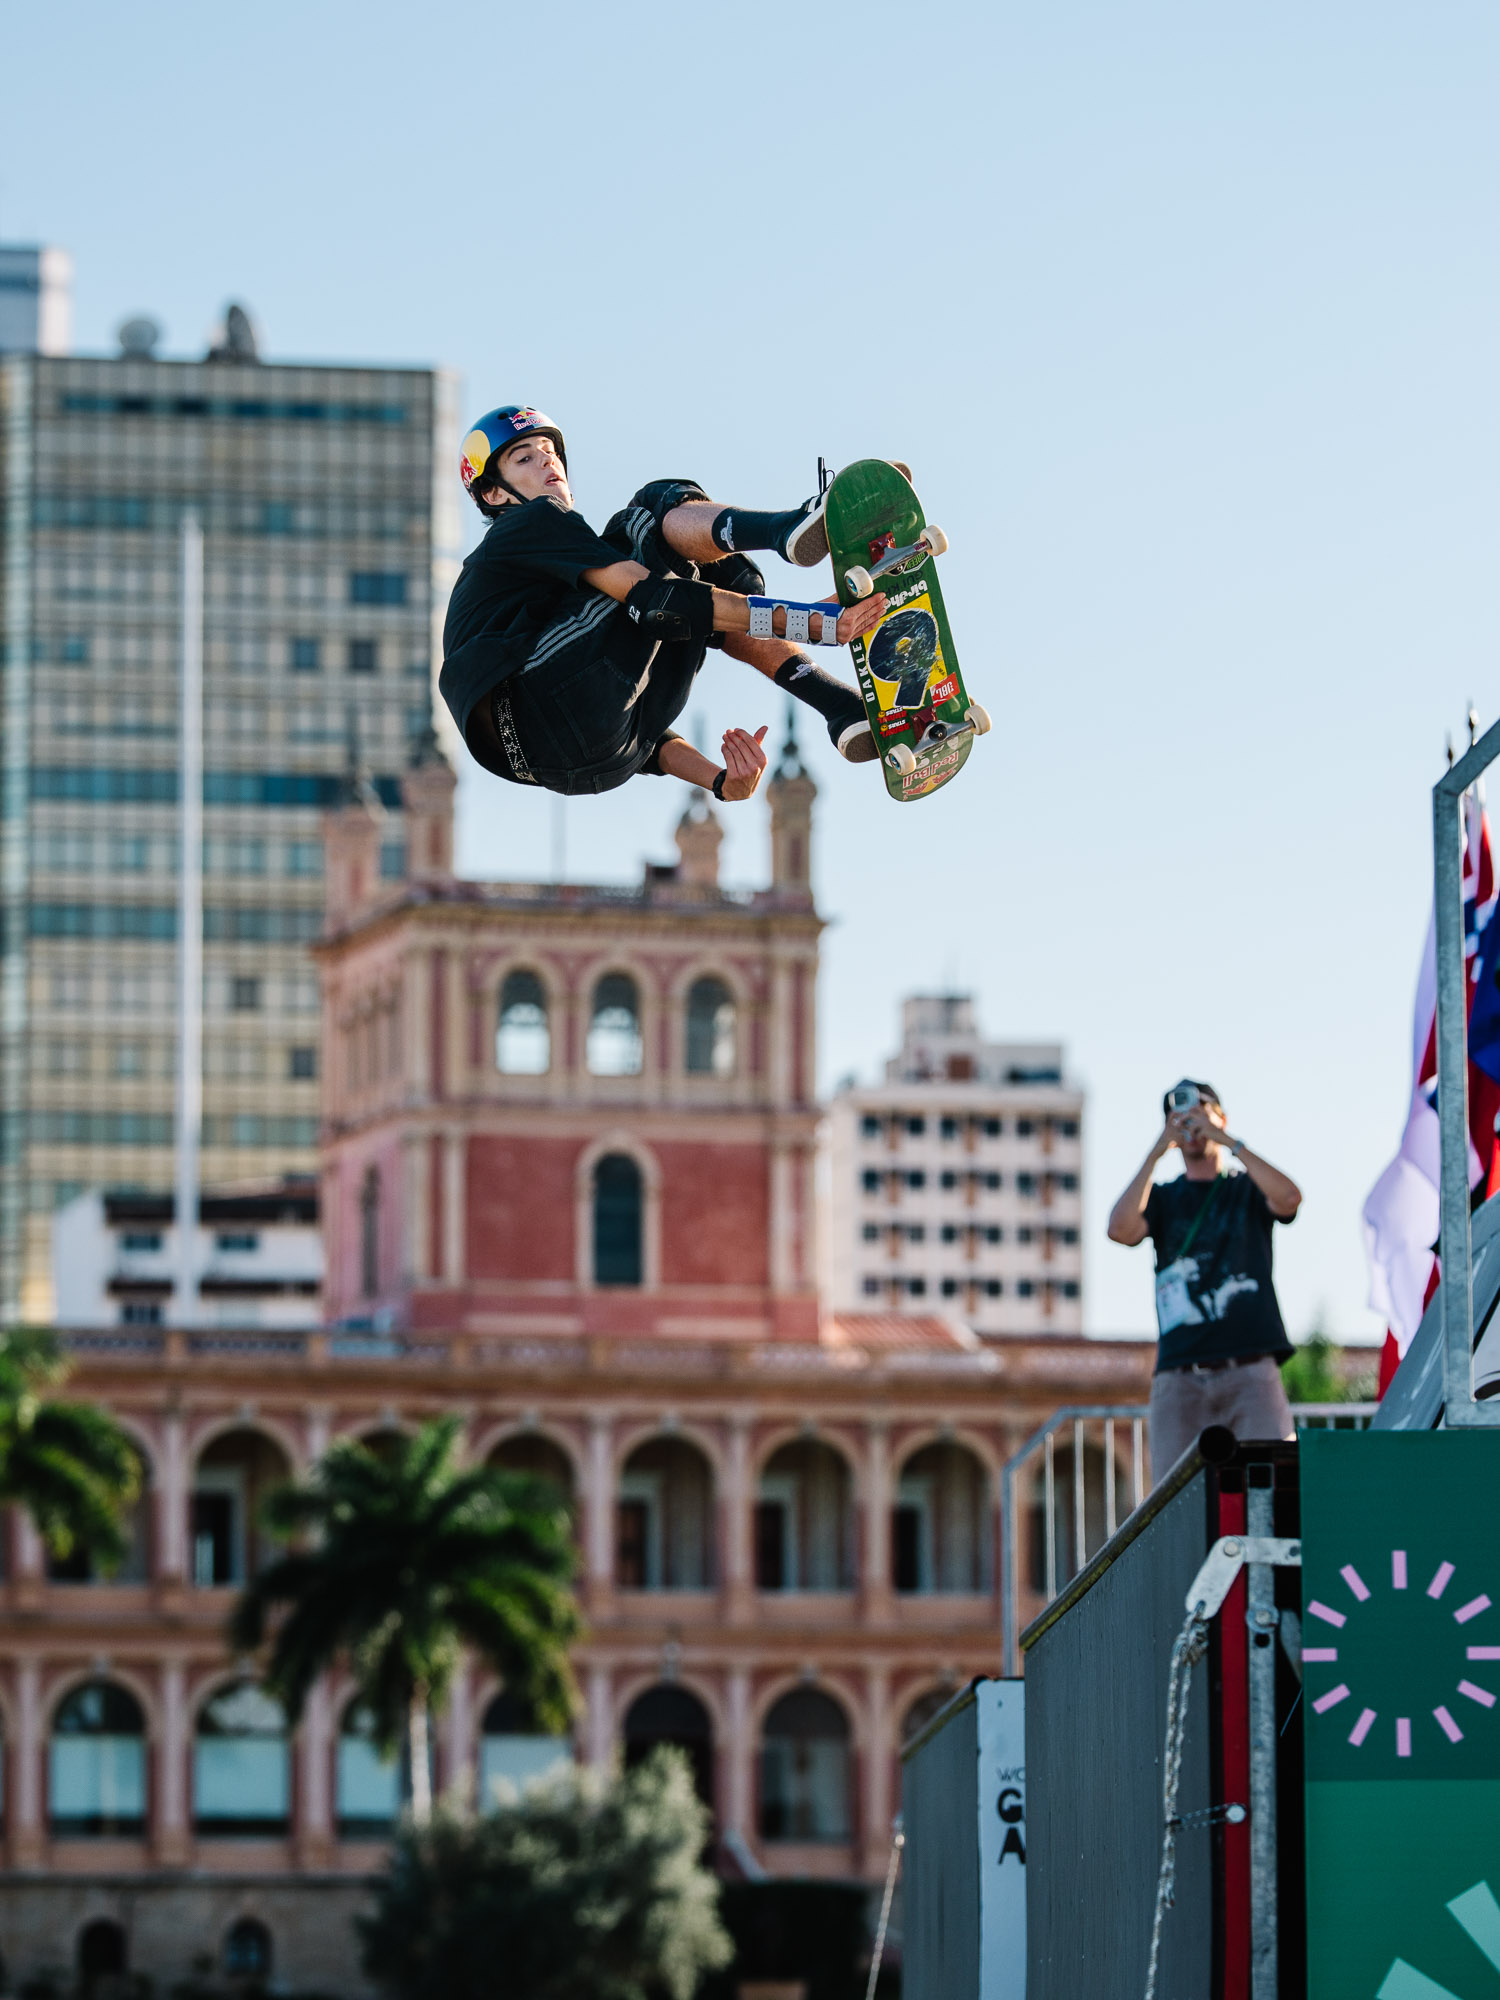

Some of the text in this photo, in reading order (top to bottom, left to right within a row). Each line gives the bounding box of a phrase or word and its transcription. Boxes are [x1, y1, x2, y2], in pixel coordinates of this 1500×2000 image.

[514, 420, 531, 430] Red
[852, 638, 876, 703] OAKLE
[936, 681, 954, 699] JBL
[902, 751, 959, 788] Red Bull
